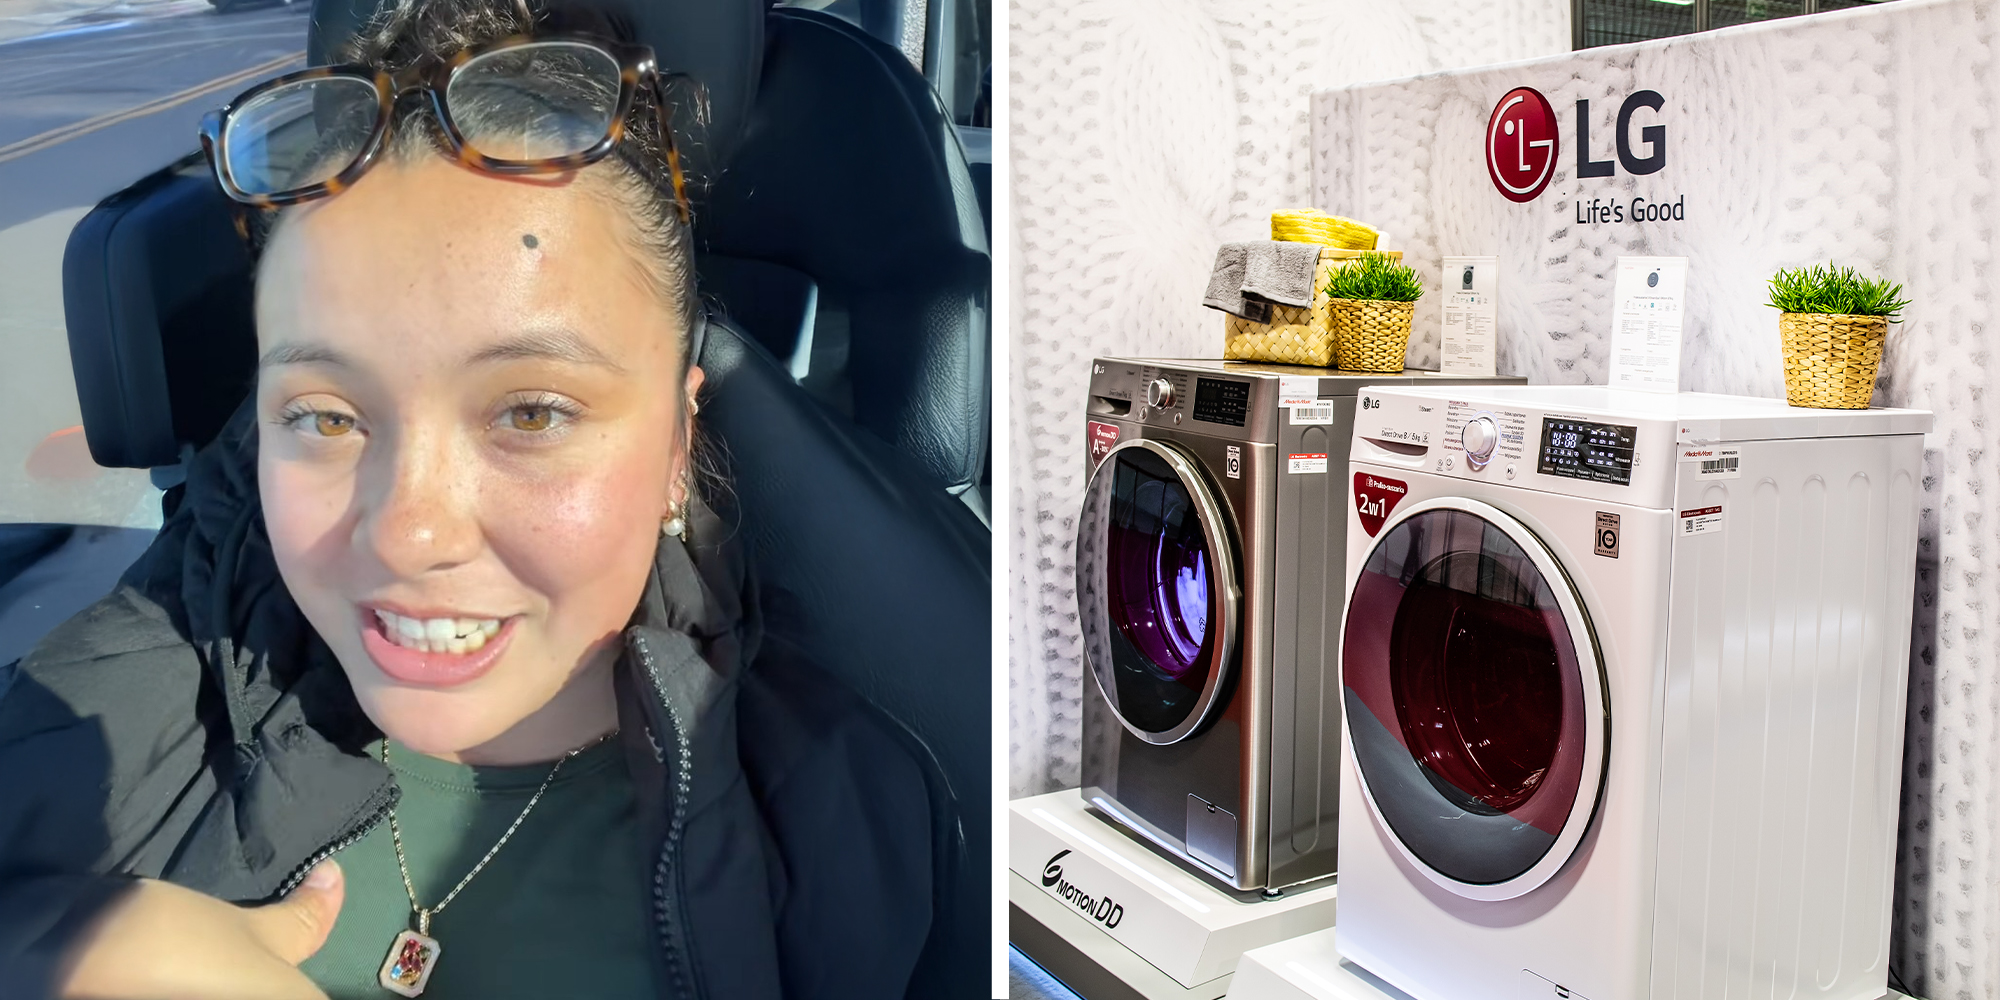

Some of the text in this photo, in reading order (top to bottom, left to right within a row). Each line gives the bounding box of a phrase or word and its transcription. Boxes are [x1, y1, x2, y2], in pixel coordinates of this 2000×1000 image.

[1576, 90, 1666, 179] LG
[1576, 194, 1684, 224] Life's Good
[1371, 399, 1380, 408] LG
[1228, 458, 1238, 473] 10
[1374, 480, 1404, 493] Pralko-suszarka
[1359, 493, 1385, 518] 2w1
[1598, 528, 1616, 549] 10
